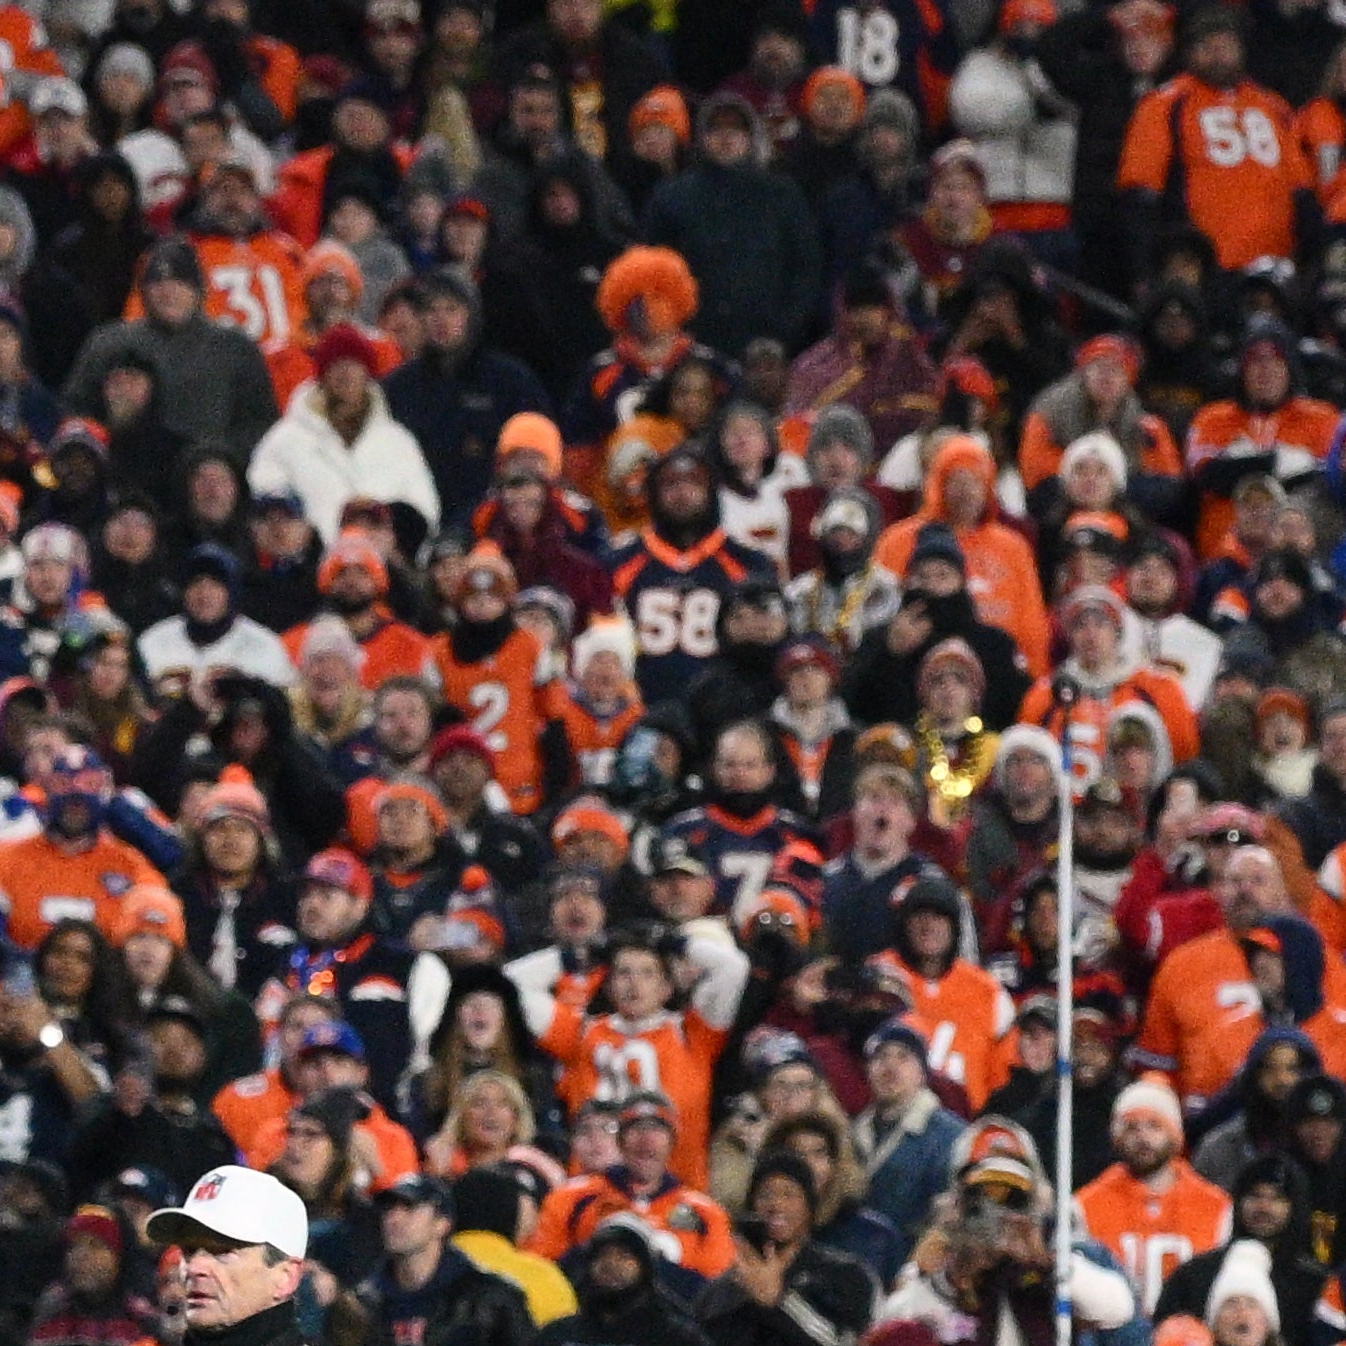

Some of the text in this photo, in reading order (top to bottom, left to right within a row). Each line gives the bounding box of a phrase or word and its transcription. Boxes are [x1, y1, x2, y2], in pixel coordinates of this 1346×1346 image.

[837, 8, 899, 83] 18
[209, 265, 291, 339] 31
[635, 587, 722, 657] 58
[721, 851, 774, 928] 7
